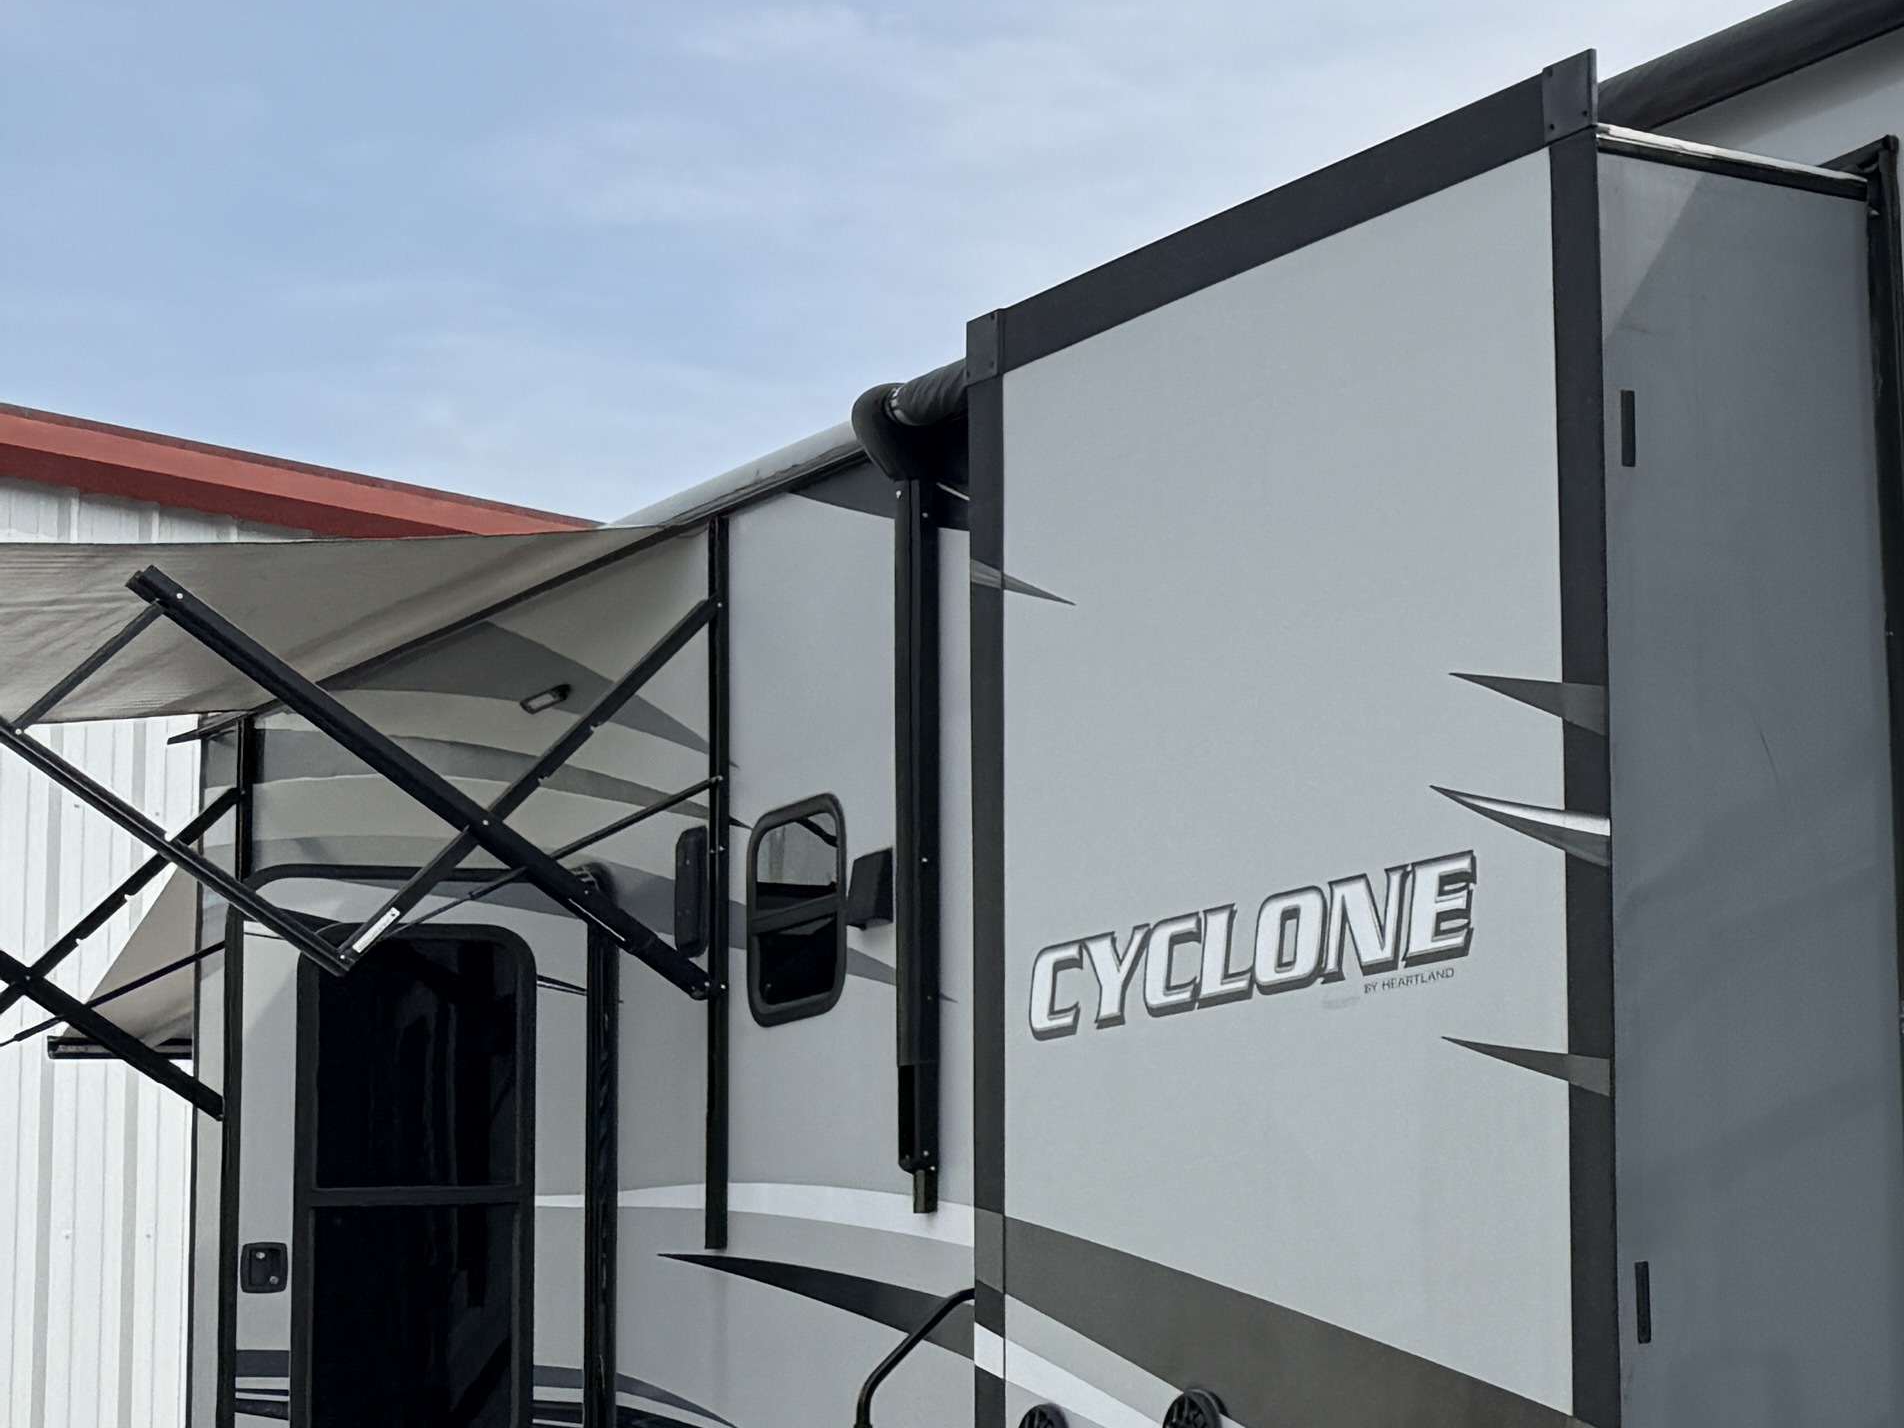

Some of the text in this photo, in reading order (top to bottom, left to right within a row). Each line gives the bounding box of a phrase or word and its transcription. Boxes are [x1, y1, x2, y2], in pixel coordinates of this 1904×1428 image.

[1028, 850, 1477, 1041] CYCLONE
[1364, 968, 1455, 994] BY HEARTLAND
